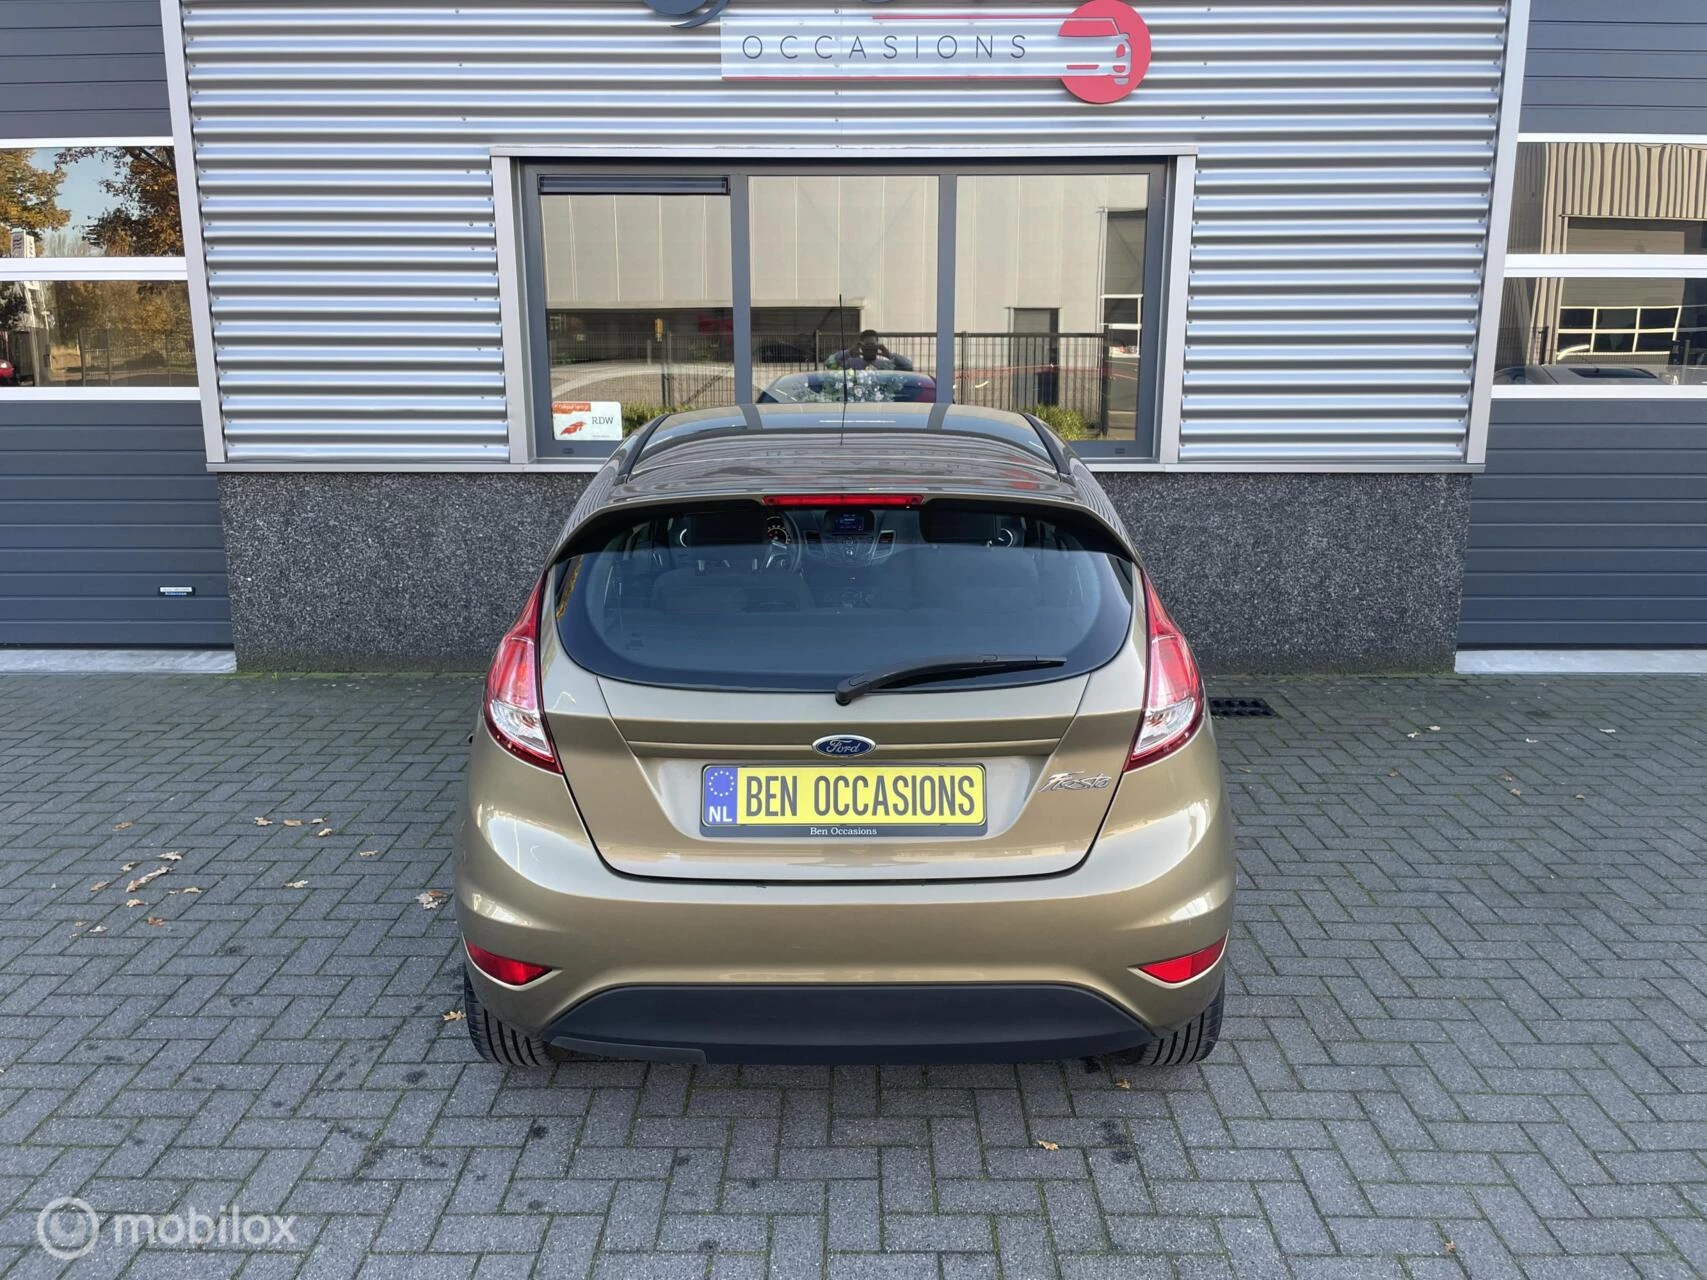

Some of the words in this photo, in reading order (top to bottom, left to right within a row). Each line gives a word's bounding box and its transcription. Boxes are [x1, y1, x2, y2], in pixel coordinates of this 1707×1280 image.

[742, 35, 1027, 59] OCCASIONS
[591, 416, 614, 425] RDW
[826, 738, 861, 754] Ford
[745, 775, 799, 817] BEN
[814, 775, 976, 817] OCCASIONS
[708, 806, 733, 823] NL
[810, 826, 828, 837] Ben
[831, 826, 878, 837] Occasions
